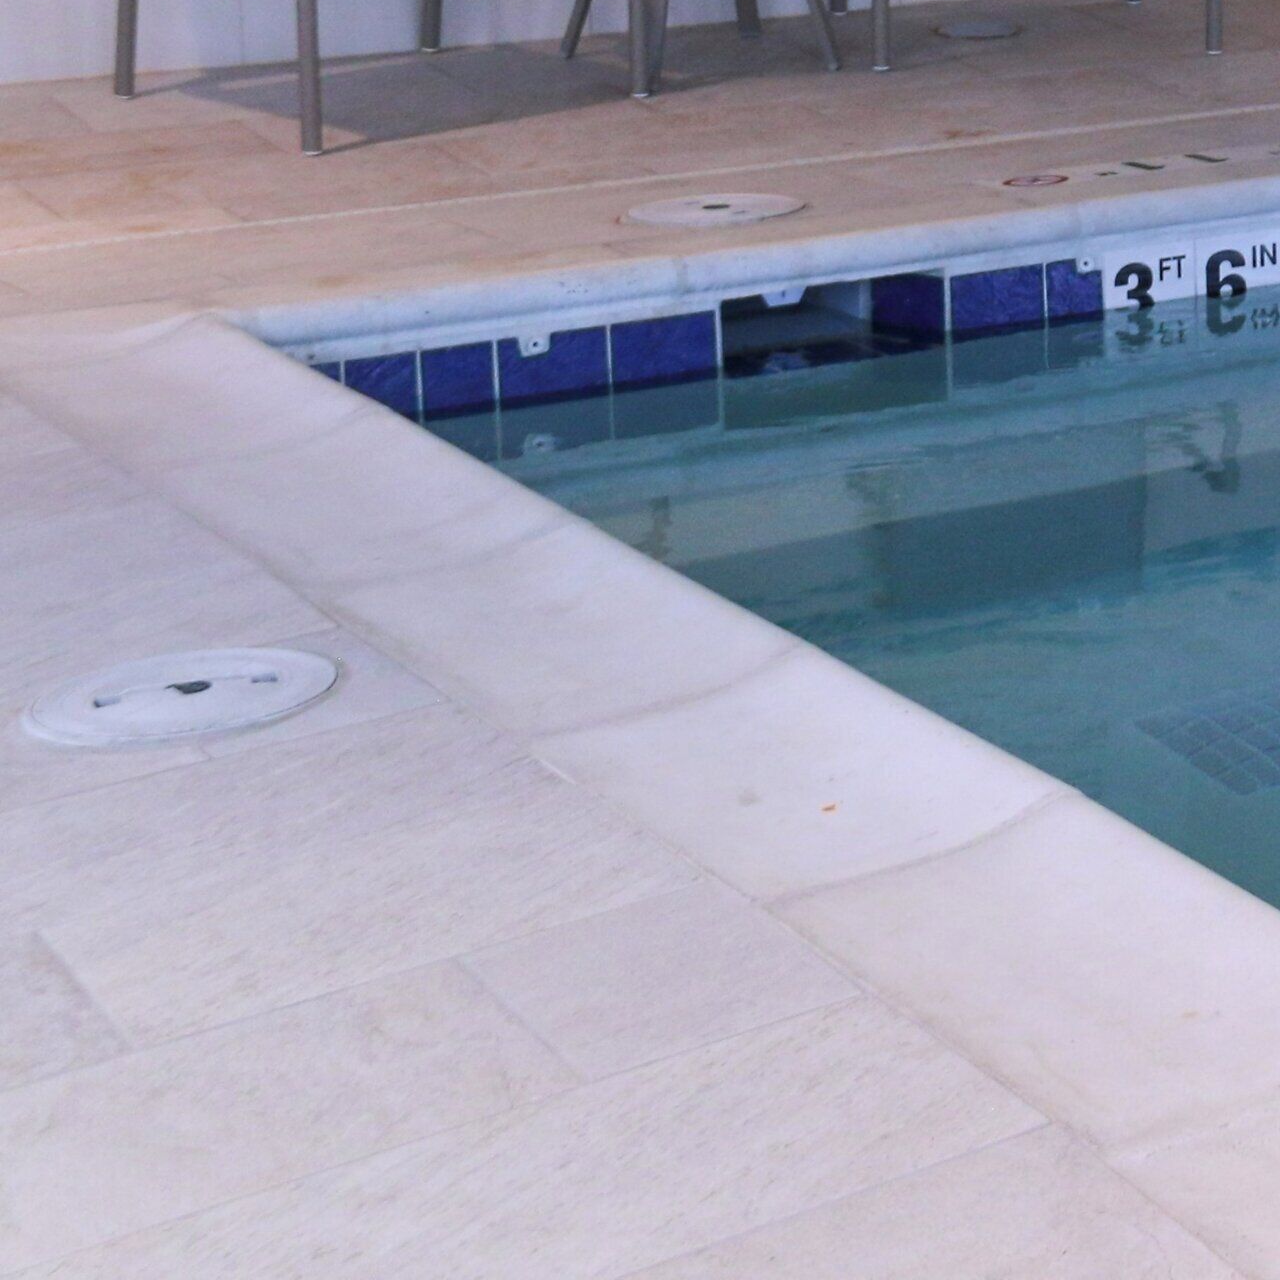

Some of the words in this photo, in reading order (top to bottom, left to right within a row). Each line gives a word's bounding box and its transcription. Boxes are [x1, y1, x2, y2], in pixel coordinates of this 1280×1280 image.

[1114, 261, 1155, 310] 3
[1158, 255, 1186, 283] FT
[1205, 248, 1246, 299] 6
[1251, 242, 1278, 269] IN
